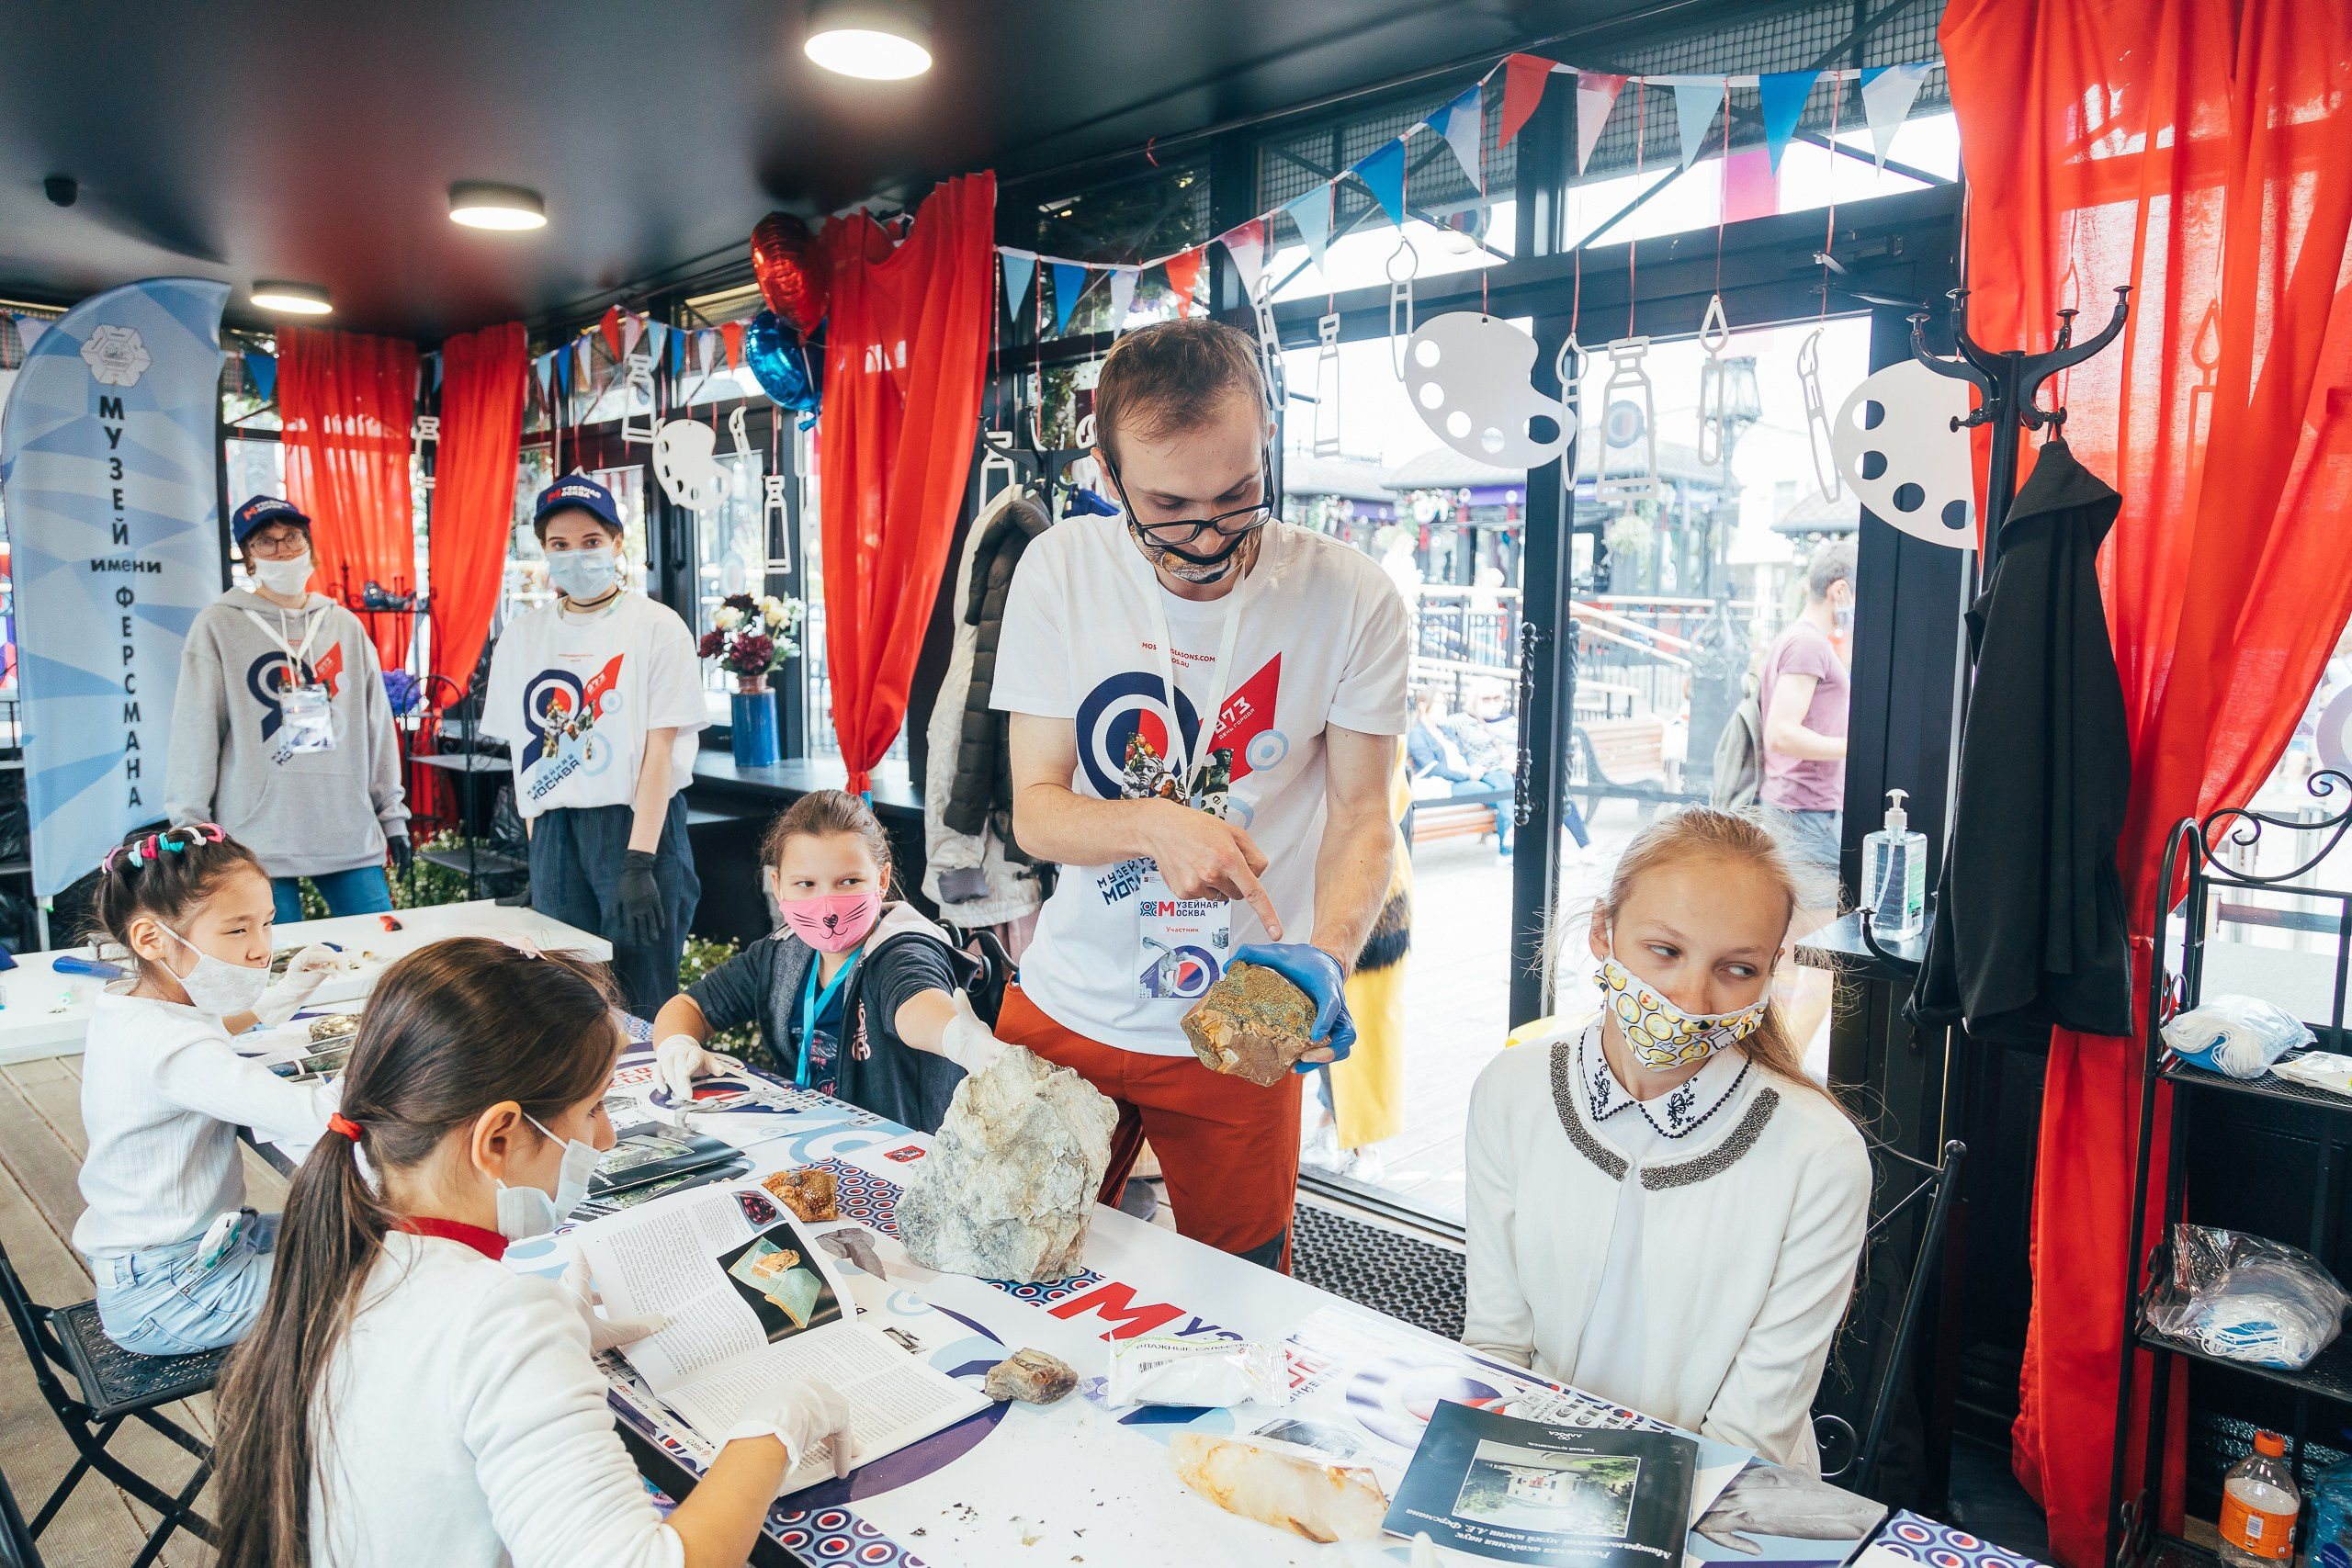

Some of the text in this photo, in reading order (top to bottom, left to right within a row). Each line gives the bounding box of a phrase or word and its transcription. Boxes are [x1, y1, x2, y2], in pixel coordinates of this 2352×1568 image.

[99, 396, 130, 546] МУЗЕЙ
[90, 558, 162, 574] имени
[1142, 642, 1216, 663] MOSSEASONS.COM
[1170, 657, 1190, 668] OS.RU
[114, 585, 141, 808] ФЕРСМАНА
[1405, 1506, 1463, 1530] Ферсмана
[1464, 1523, 1490, 1537] А.Е.
[1492, 1528, 1526, 1542] имени
[1454, 1531, 1611, 1560] Российская академия наук
[1526, 1533, 1564, 1547] музей
